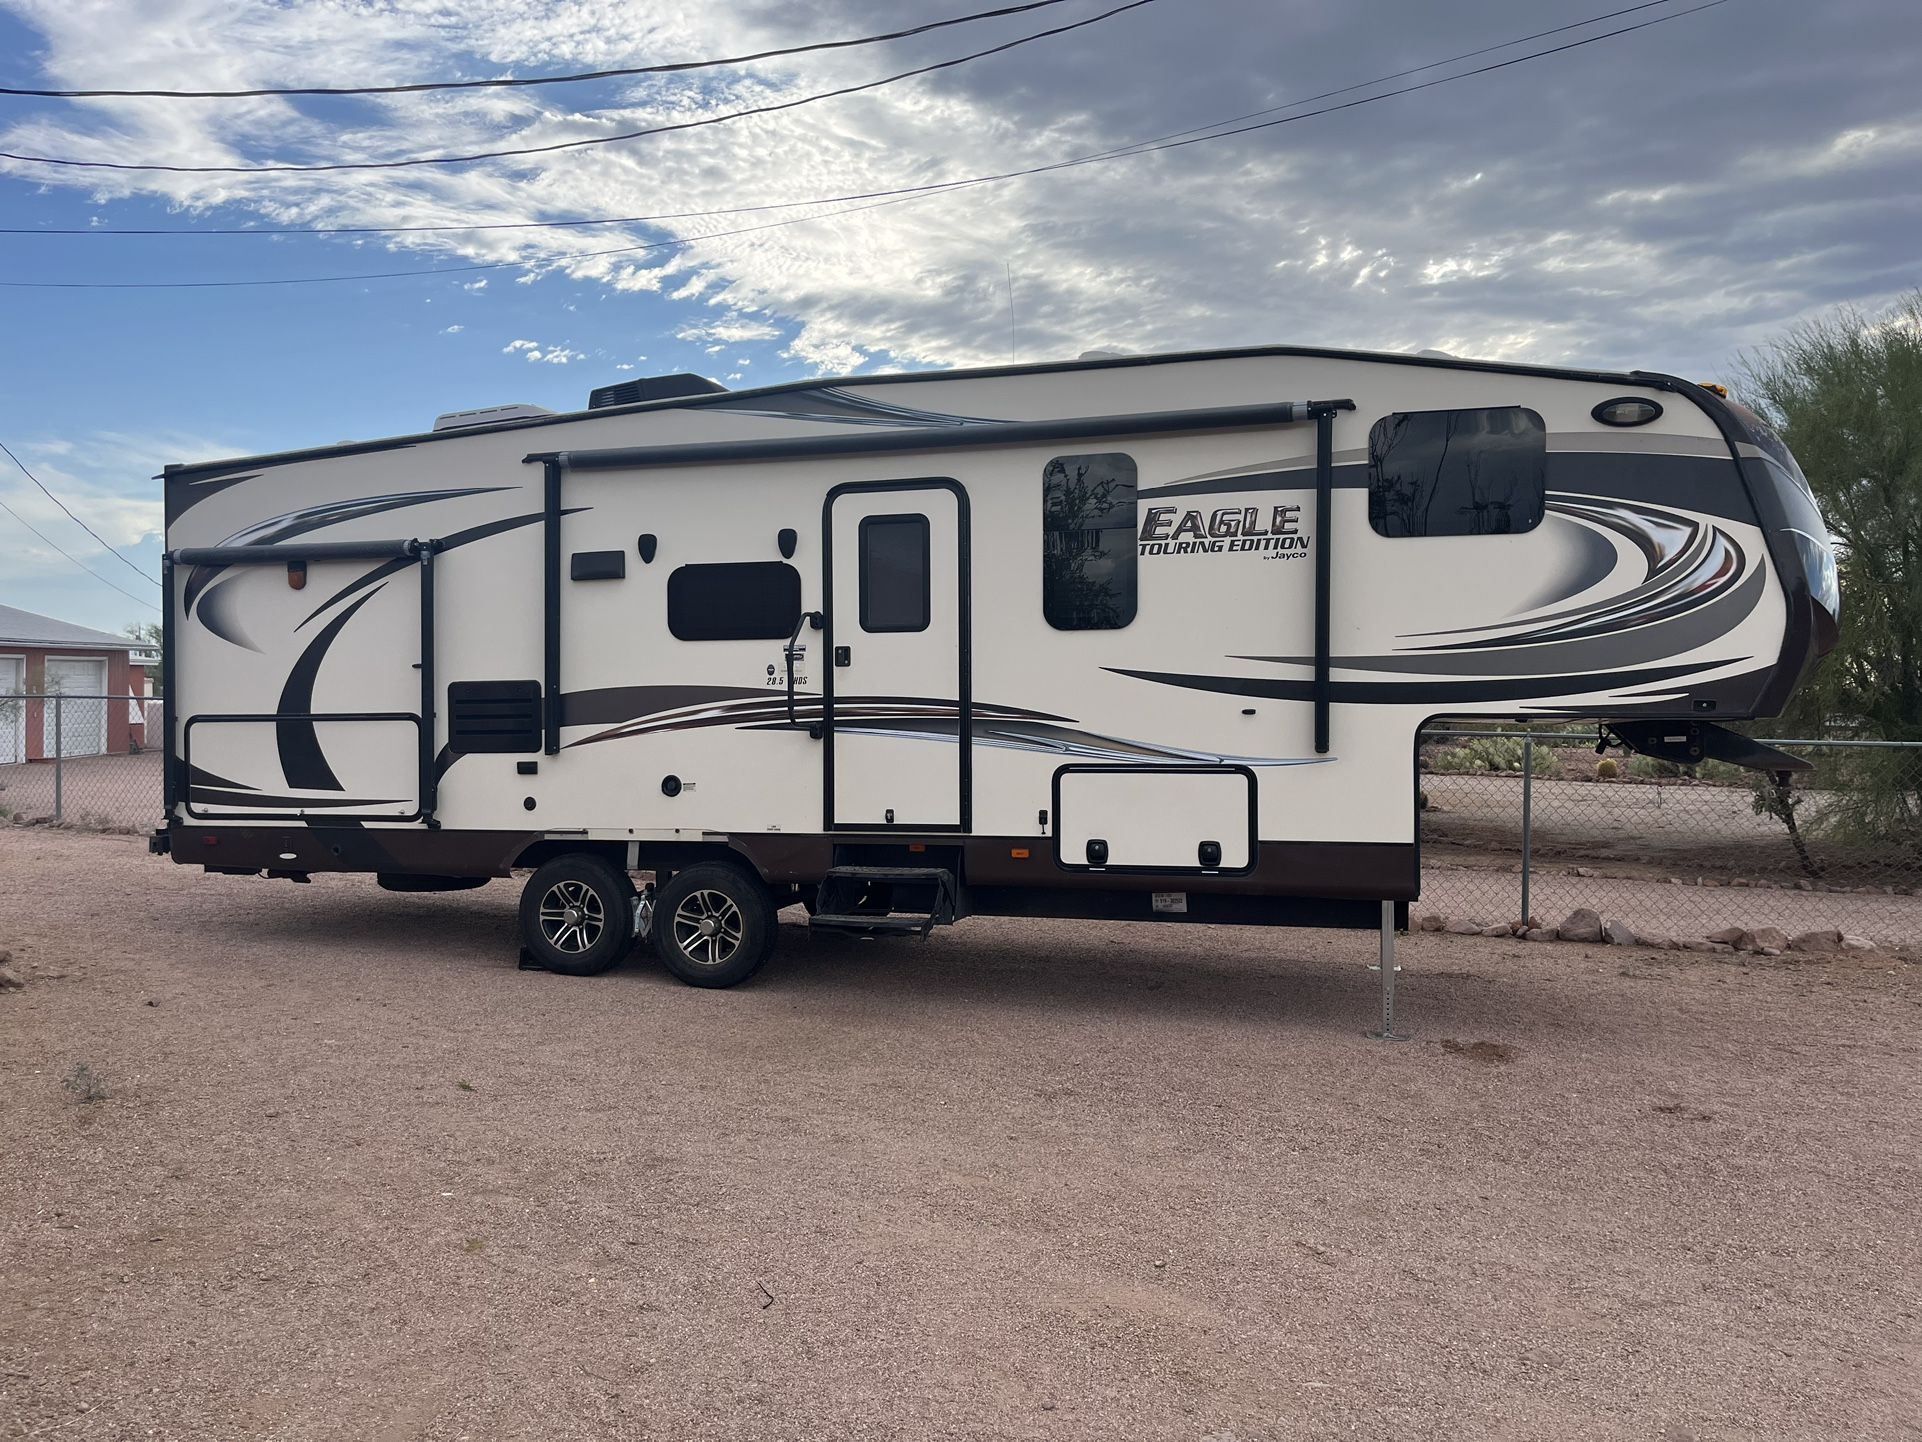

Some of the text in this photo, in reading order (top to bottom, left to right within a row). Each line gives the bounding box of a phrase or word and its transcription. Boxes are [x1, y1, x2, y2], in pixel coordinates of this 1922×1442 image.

[1138, 505, 1300, 541] EAGLE
[1138, 536, 1311, 556] TOURING EDITION
[1271, 551, 1307, 561] Jayco
[766, 676, 784, 686] 28.5
